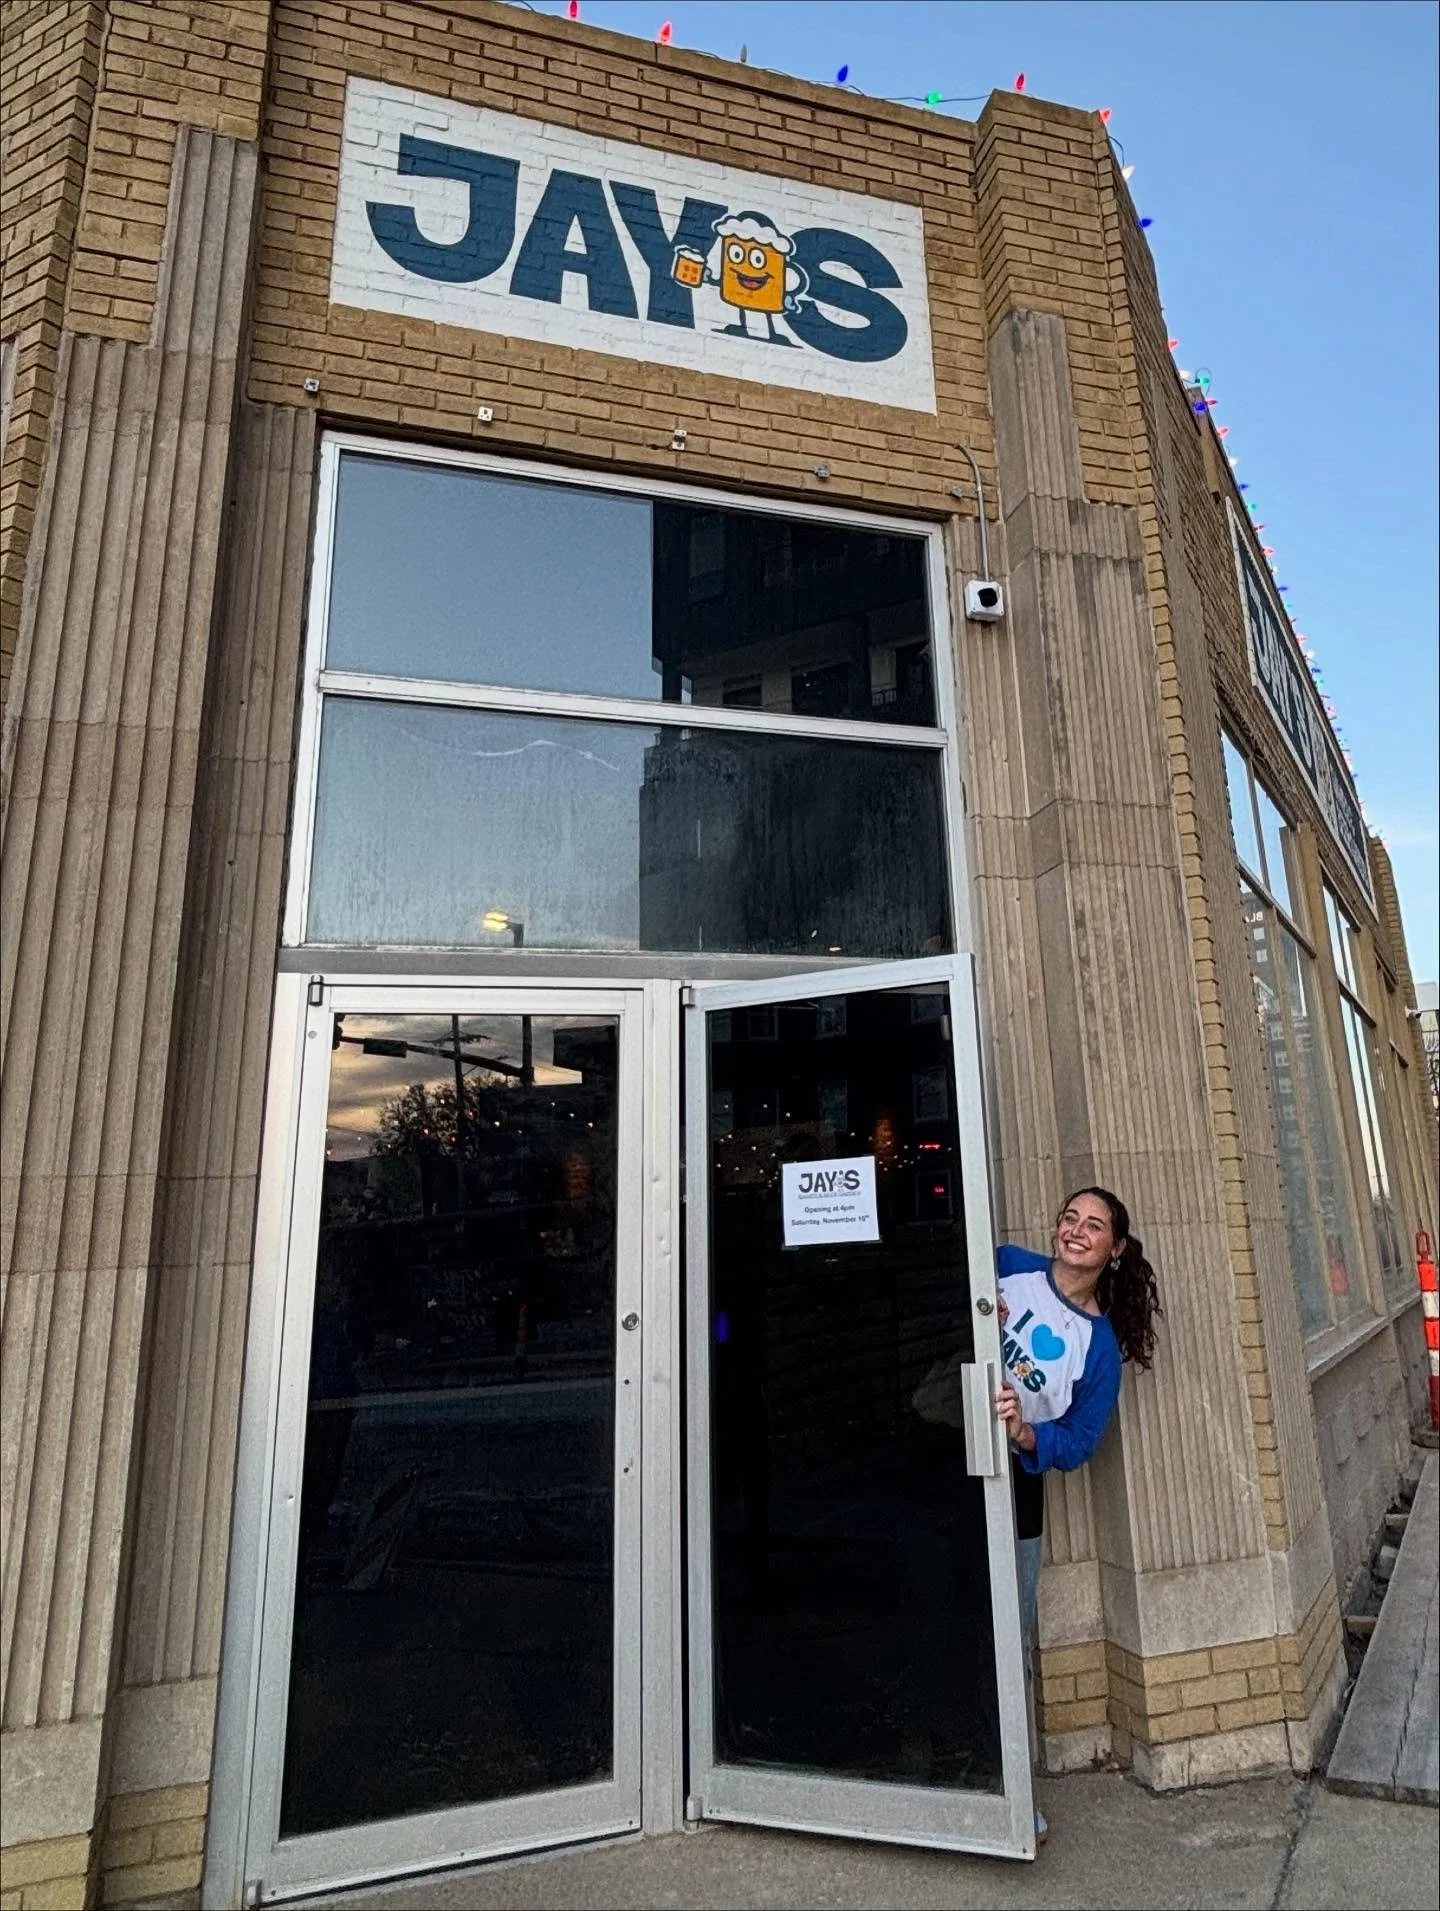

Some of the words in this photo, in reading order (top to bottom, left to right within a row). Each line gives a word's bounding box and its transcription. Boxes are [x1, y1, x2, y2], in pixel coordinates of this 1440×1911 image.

[798, 1169, 861, 1193] JAY'S
[840, 1204, 856, 1212] 4pm
[822, 1216, 857, 1224] November
[1012, 1308, 1034, 1334] I
